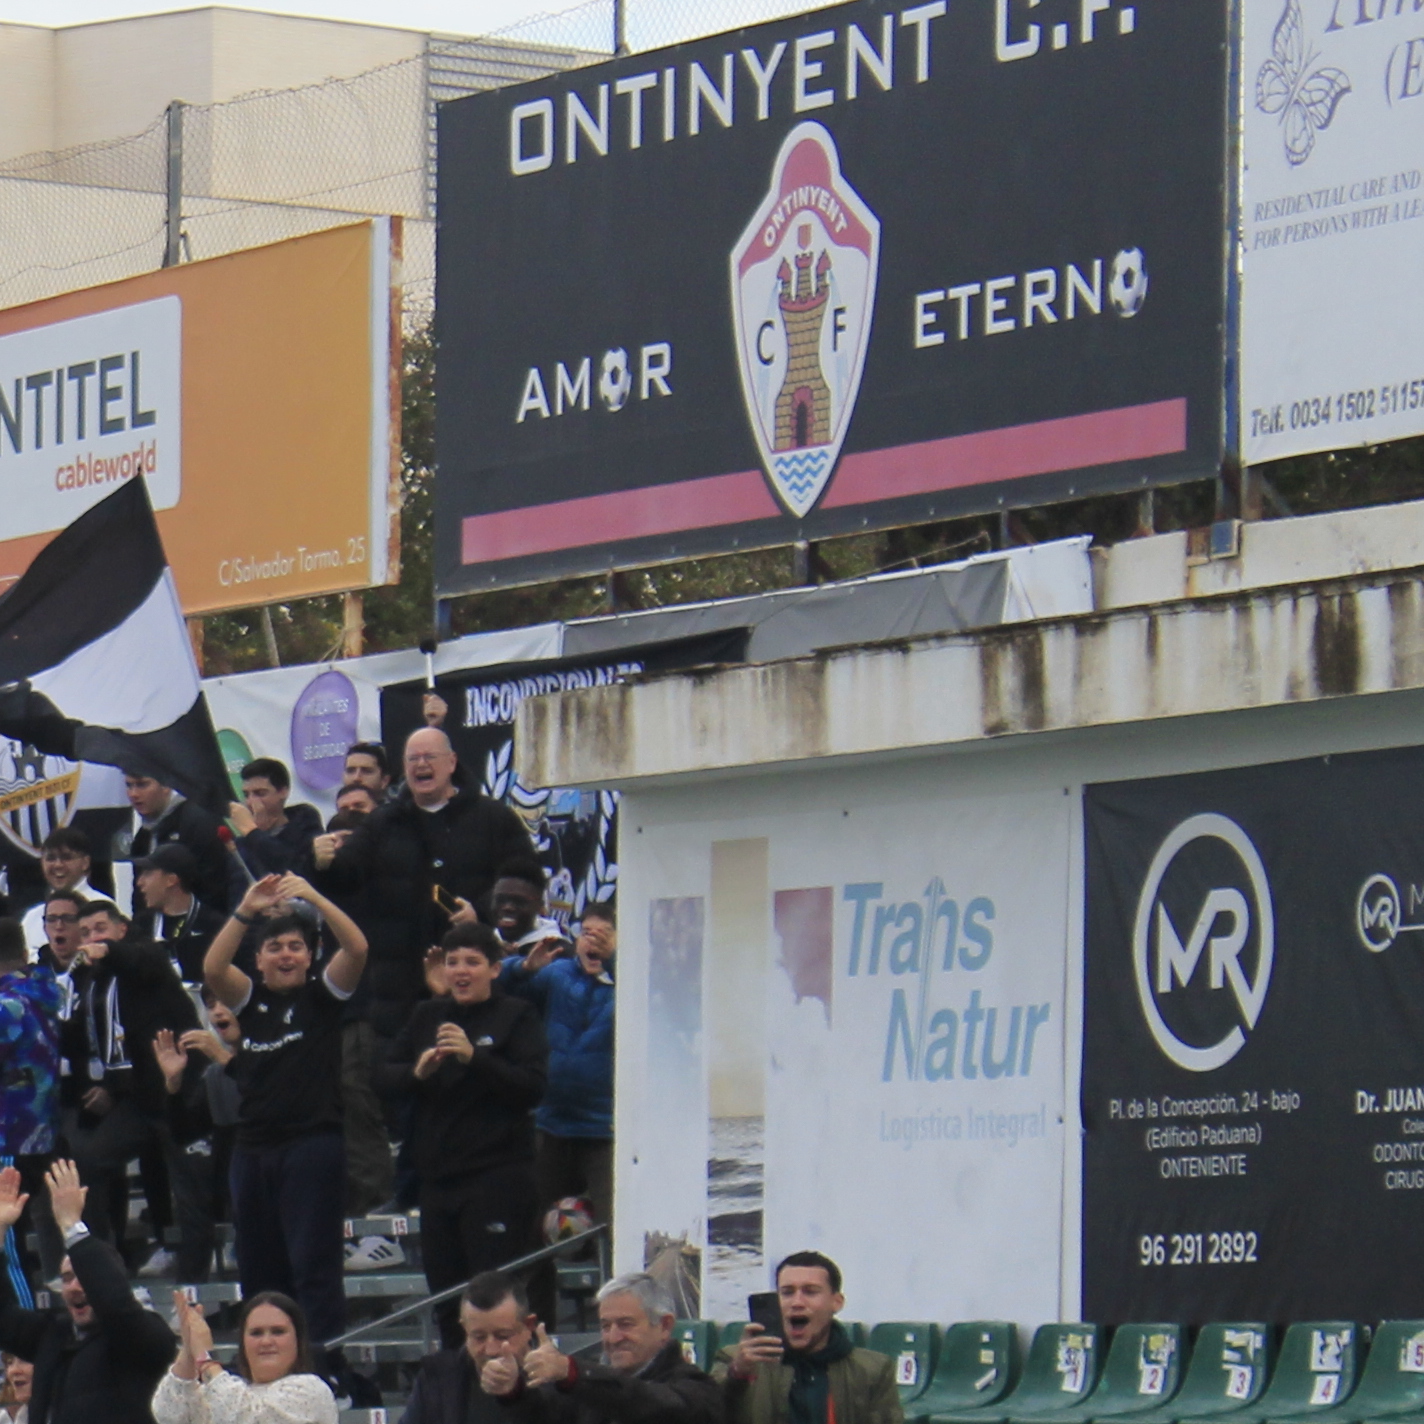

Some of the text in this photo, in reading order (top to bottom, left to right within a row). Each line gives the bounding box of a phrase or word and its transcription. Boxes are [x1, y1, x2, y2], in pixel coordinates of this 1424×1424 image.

[510, 0, 947, 176] ONTINYENT
[763, 186, 847, 247] ONTINYENT
[1254, 170, 1421, 222] RESIDENTIAL CARE AND
[1254, 227, 1282, 250] FOR
[1284, 214, 1349, 244] PERSONS
[1352, 205, 1389, 229] WITH
[1252, 404, 1284, 437] Telf.
[1291, 396, 1331, 430] 0034
[1337, 389, 1375, 422] 1502
[56, 439, 156, 491] cableworld
[347, 536, 366, 564] 25
[843, 881, 995, 977] Trans
[882, 988, 1050, 1082] Natur
[1128, 1099, 1144, 1119] de
[1148, 1098, 1159, 1118] la
[1242, 1091, 1258, 1112] 24
[1271, 1089, 1300, 1114] bajo
[1356, 1090, 1380, 1114] Dr.
[1146, 1122, 1262, 1150] (Edificio Paduana)
[1161, 1154, 1247, 1178] ONTENIENTE
[1140, 1231, 1257, 1266] 96 291 2892
